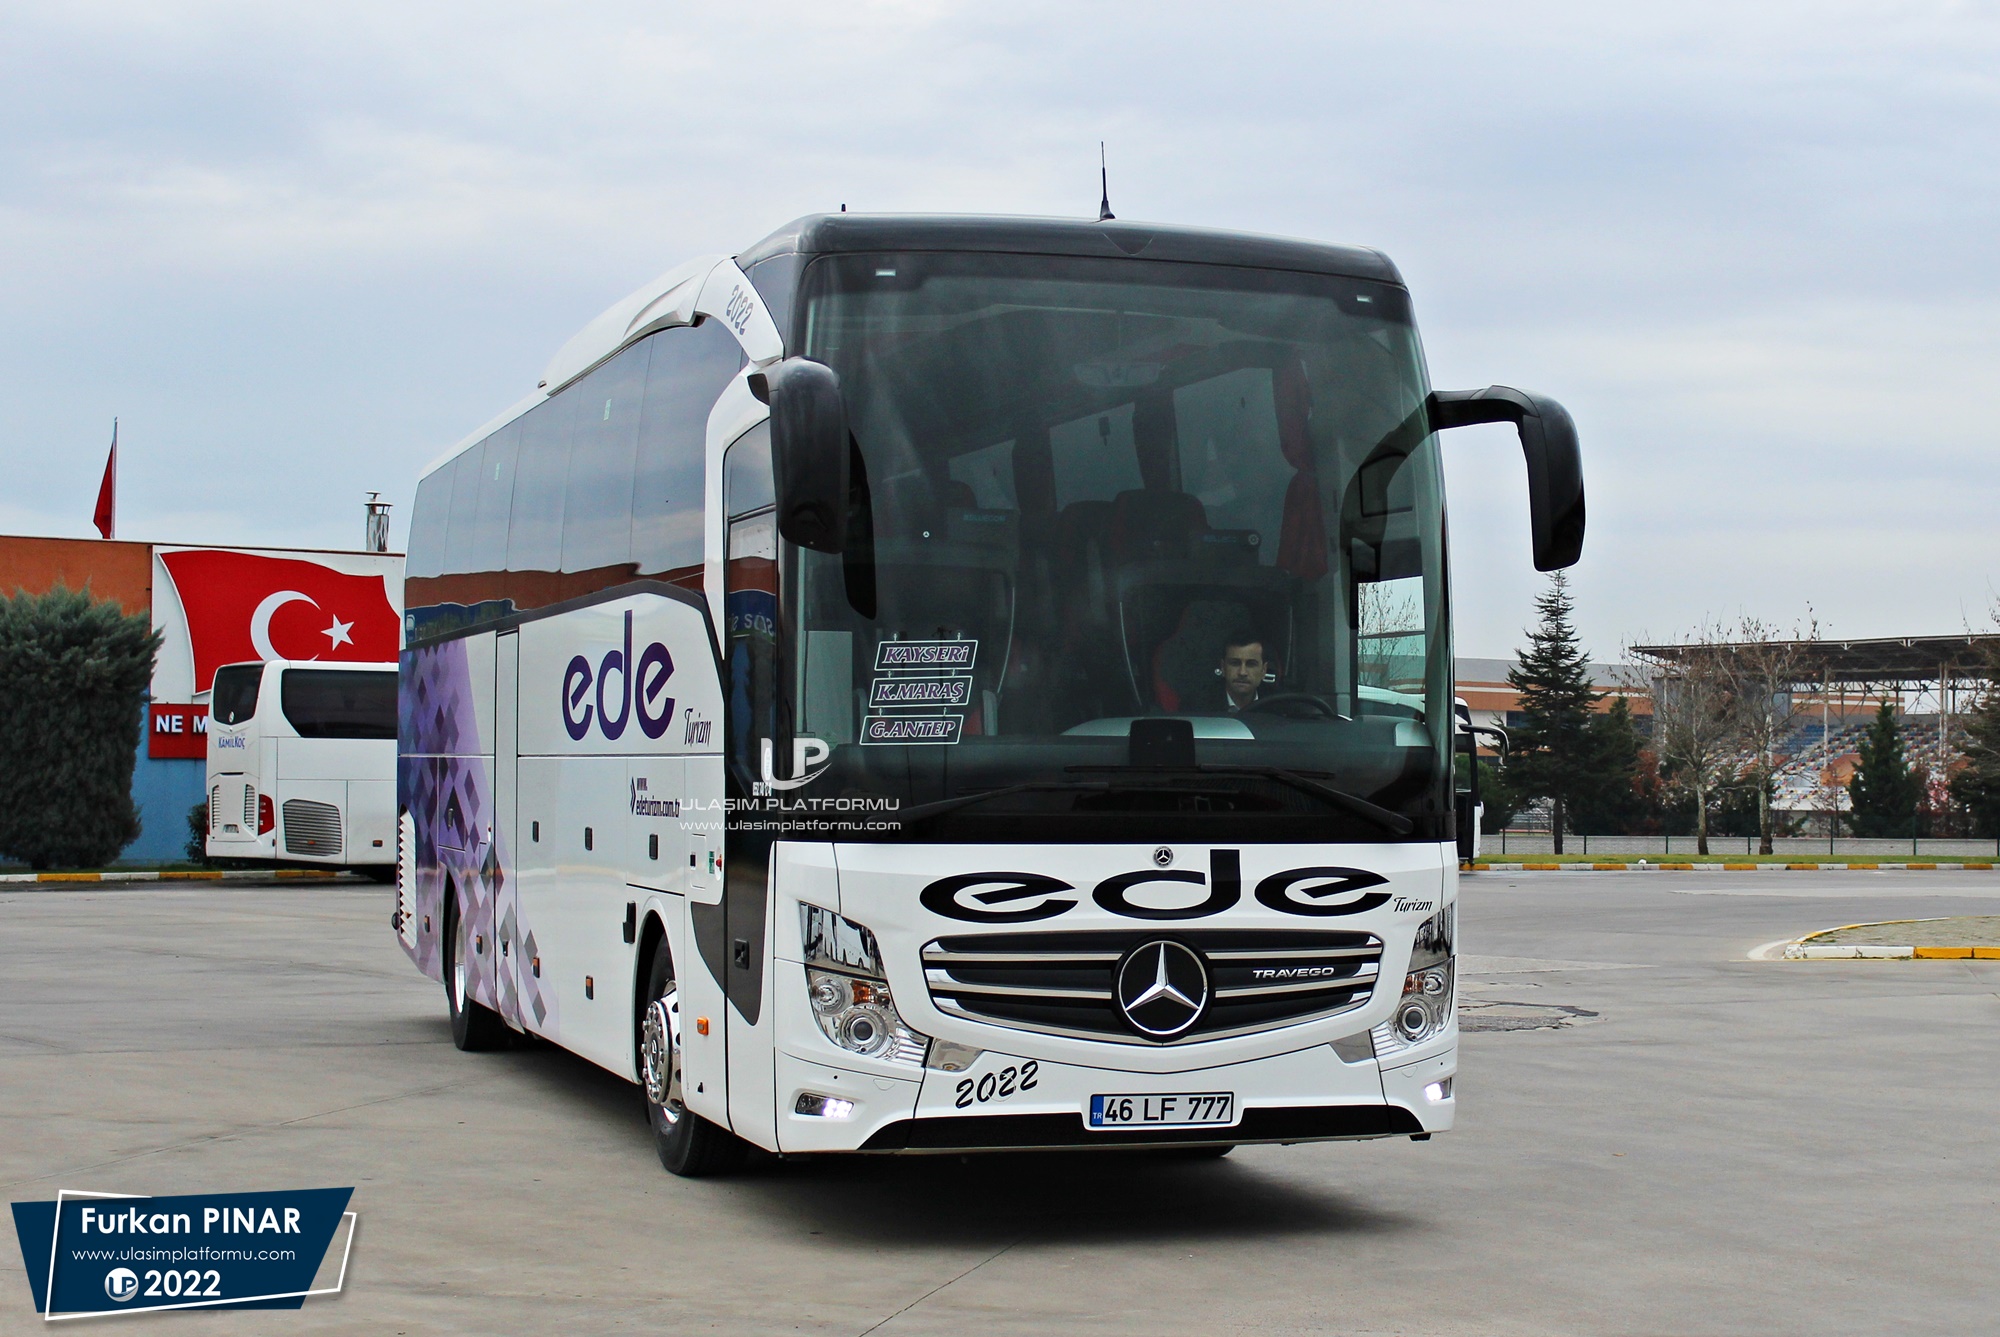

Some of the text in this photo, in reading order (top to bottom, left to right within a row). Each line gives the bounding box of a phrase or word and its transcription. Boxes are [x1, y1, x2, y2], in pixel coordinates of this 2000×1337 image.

[726, 284, 754, 335] 2022
[562, 609, 712, 747] ede Turizm
[875, 681, 965, 703] K.MARAŞ
[156, 714, 184, 733] NE
[869, 720, 957, 738] G.ANTEP
[919, 848, 1433, 924] ede Turizm
[1252, 967, 1335, 979] TRAVEGO
[955, 1060, 1039, 1109] 2022
[1105, 1098, 1133, 1121] 46
[1143, 1097, 1178, 1121] LF
[1188, 1096, 1230, 1120] 777
